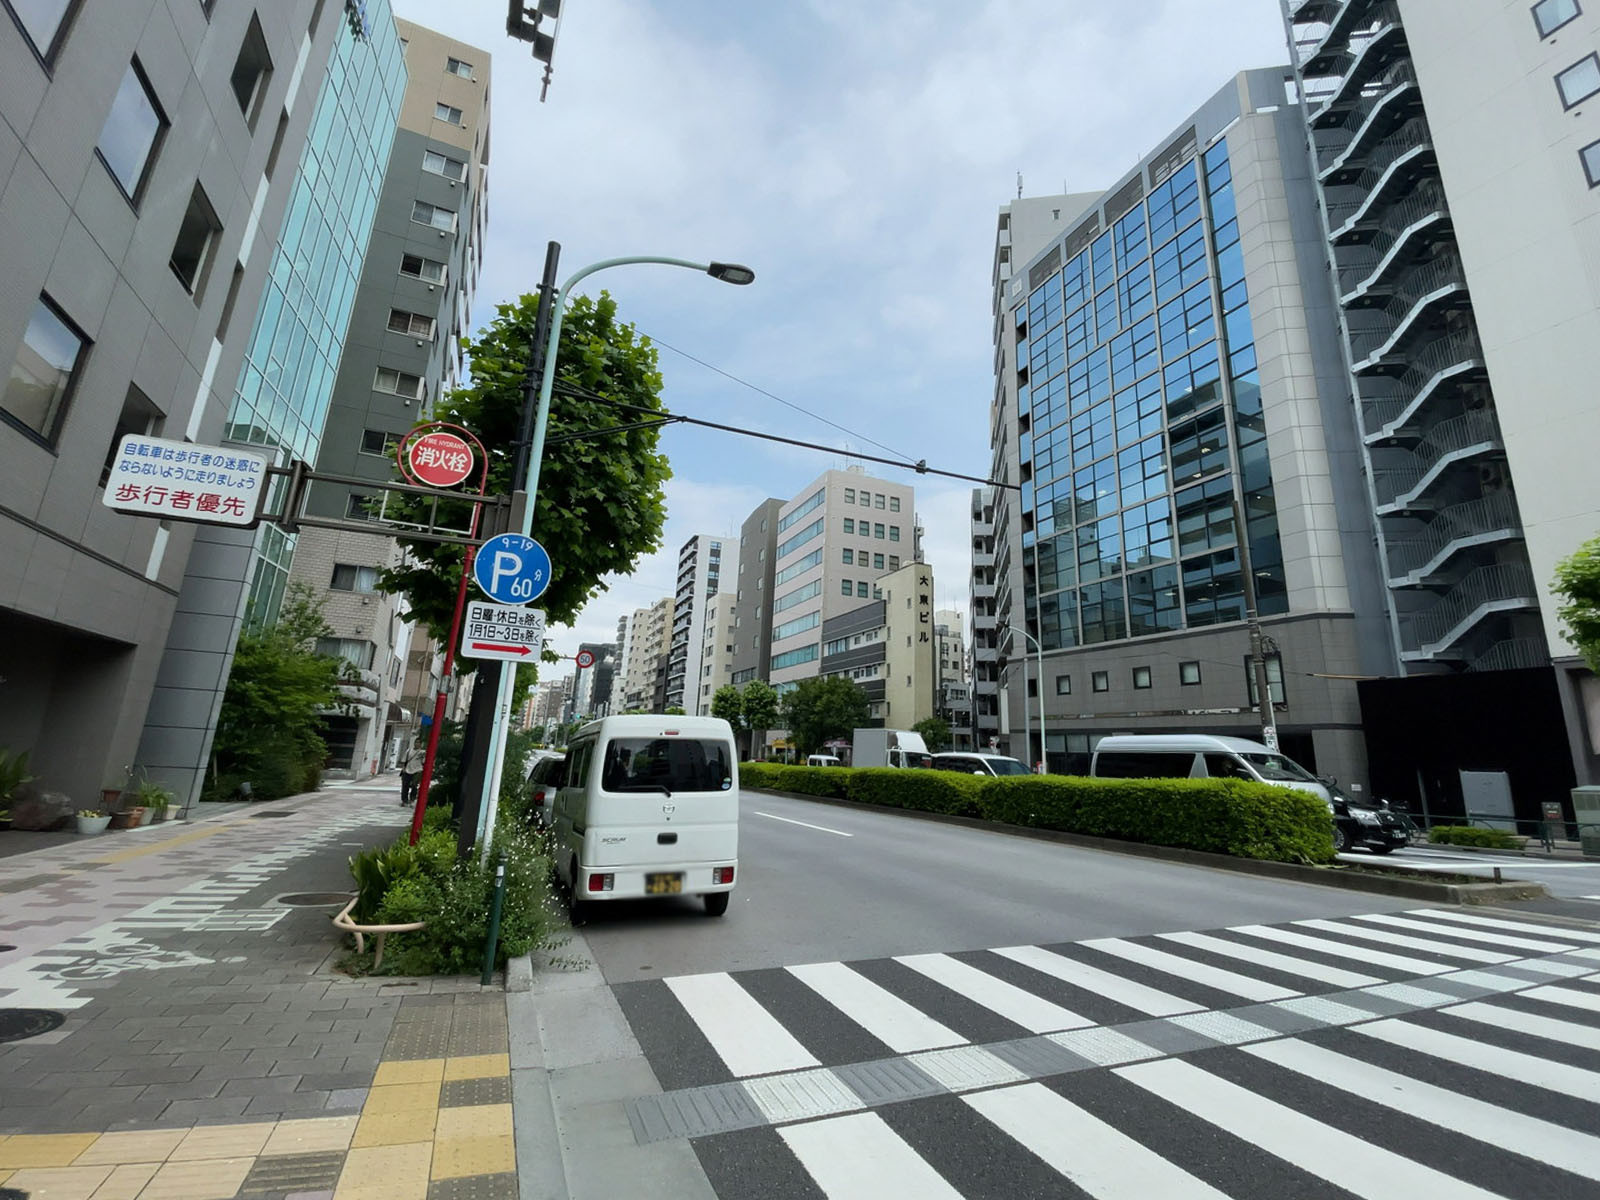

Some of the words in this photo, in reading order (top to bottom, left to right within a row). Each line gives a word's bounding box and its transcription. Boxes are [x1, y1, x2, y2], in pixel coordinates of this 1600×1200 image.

[123, 442, 261, 473] 自転車は歩行者の迷惑に
[415, 445, 468, 473] 消火栓
[118, 459, 256, 490] ならないように走りましょう
[115, 483, 247, 517] 歩行者優先
[501, 537, 534, 552] 9-19
[490, 550, 523, 594] P
[580, 655, 591, 664] 50
